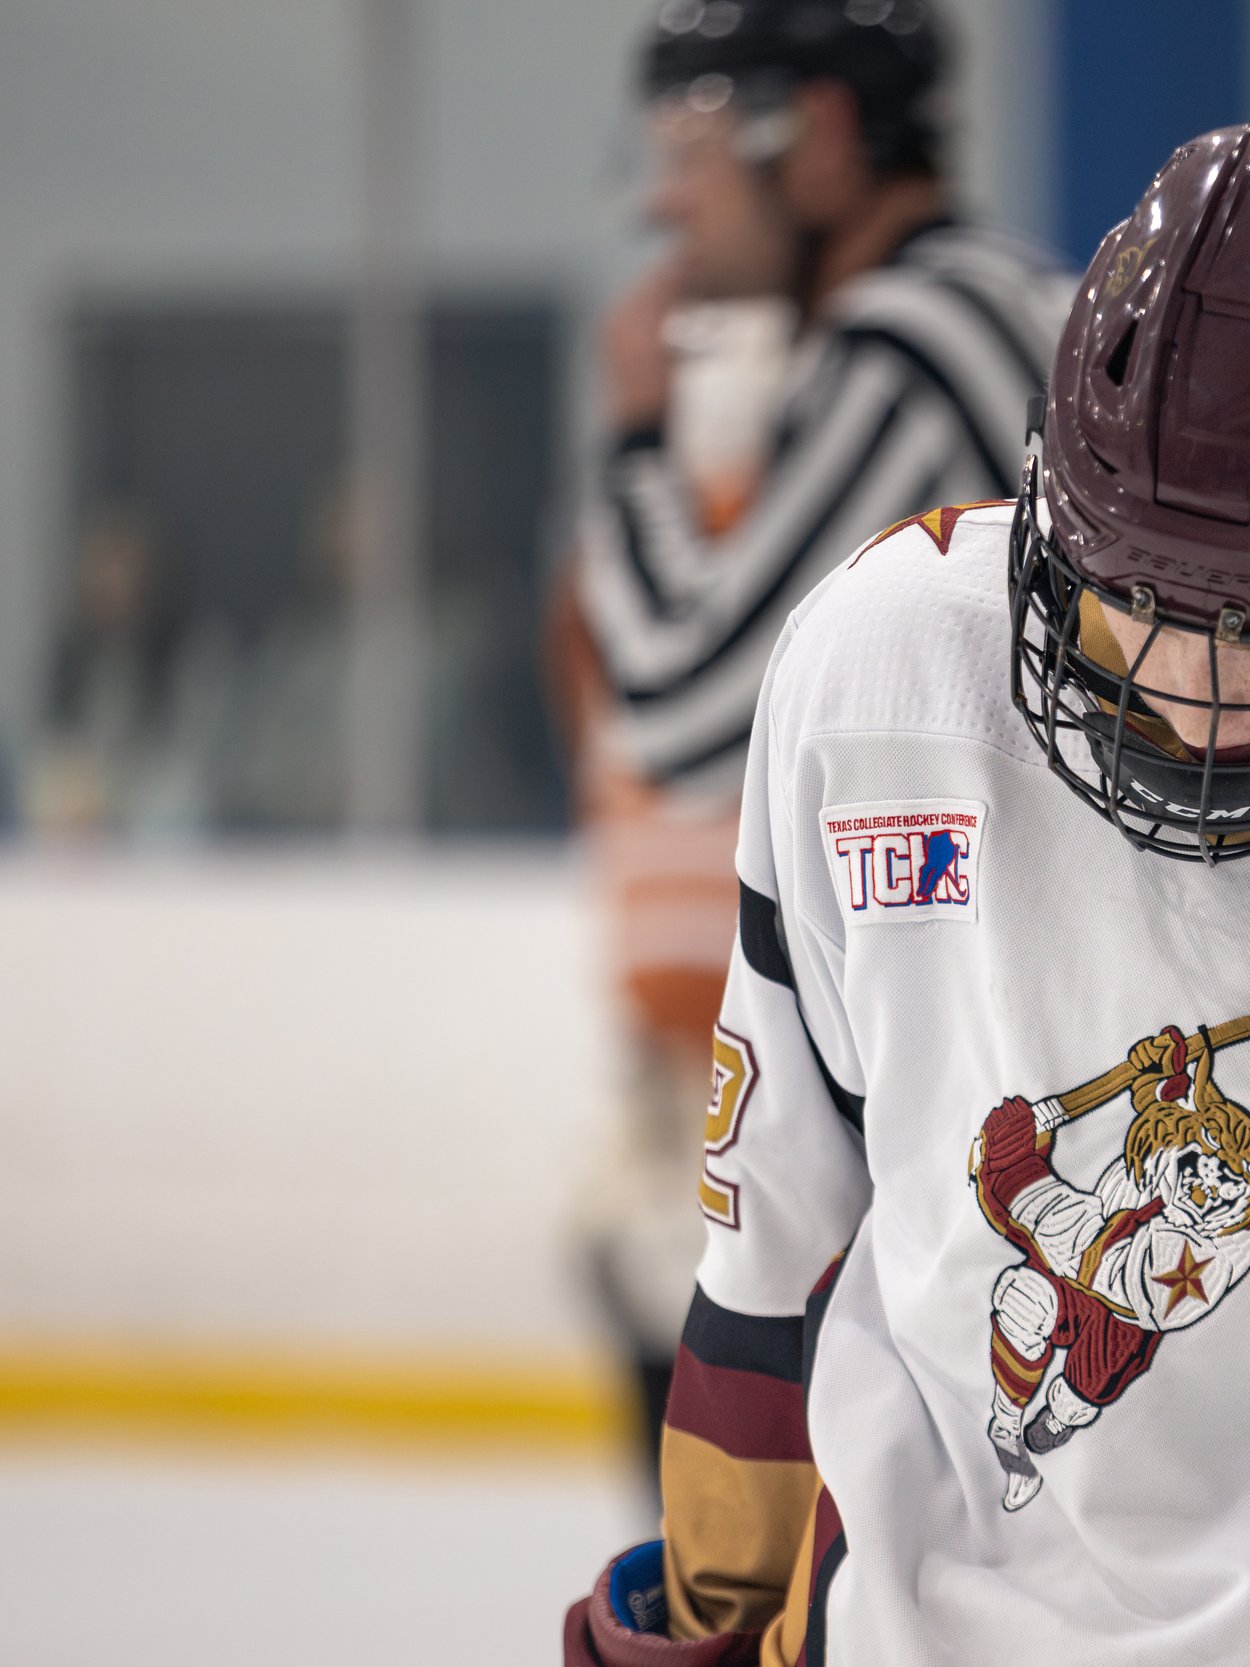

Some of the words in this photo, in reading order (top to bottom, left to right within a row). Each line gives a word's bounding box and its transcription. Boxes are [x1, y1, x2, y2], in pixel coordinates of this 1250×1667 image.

[827, 820, 853, 833] TEXAS
[853, 816, 902, 831] COLLEGIATE
[903, 814, 940, 827] HOCKEY
[941, 813, 977, 828] CONFERENCE
